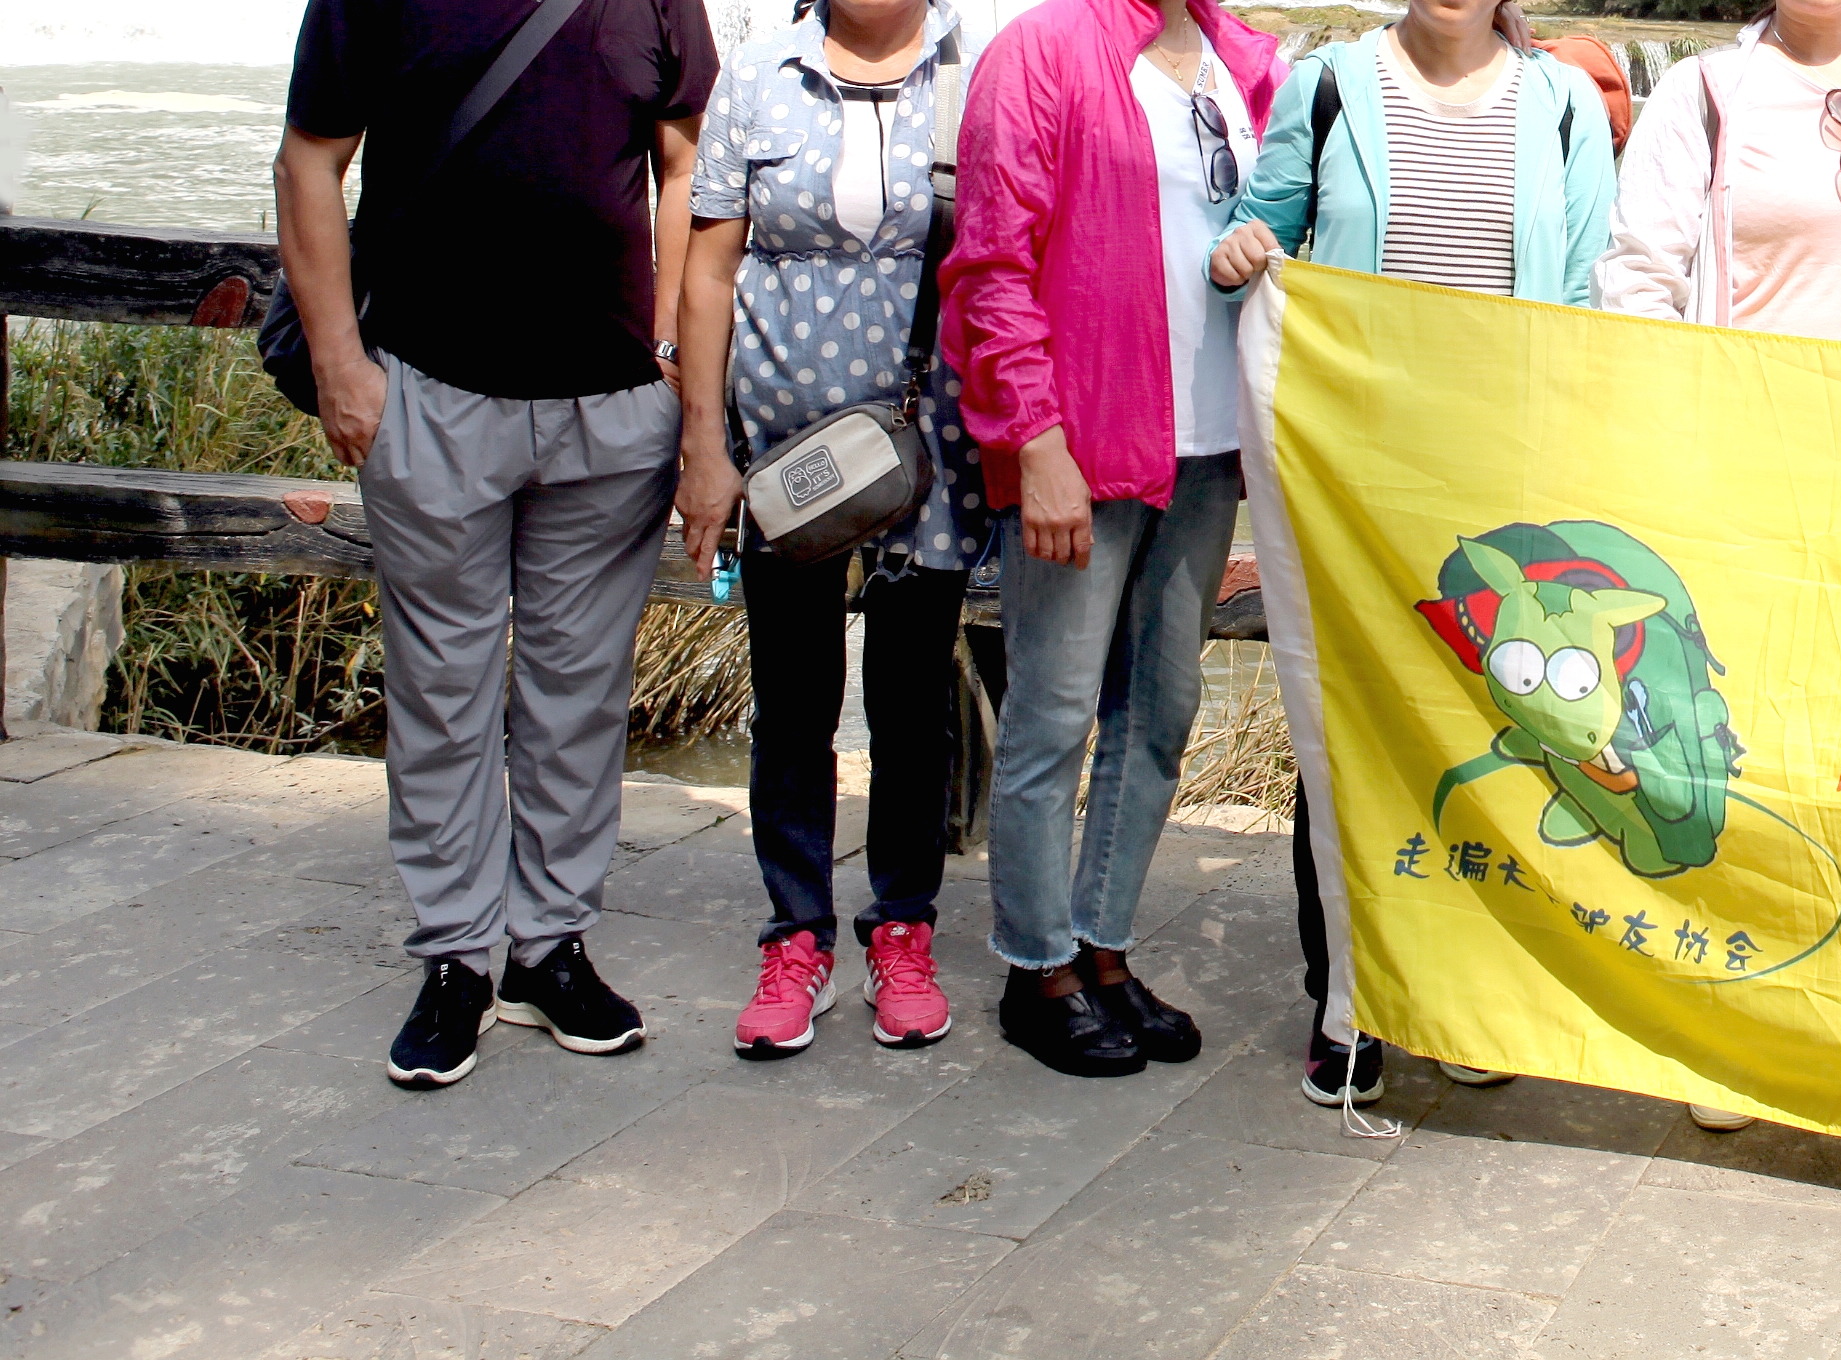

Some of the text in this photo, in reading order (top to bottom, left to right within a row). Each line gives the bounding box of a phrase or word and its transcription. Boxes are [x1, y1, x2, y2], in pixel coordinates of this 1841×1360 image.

[812, 469, 830, 484] IT'S
[1393, 831, 1763, 971] 走遍天驴友协会
